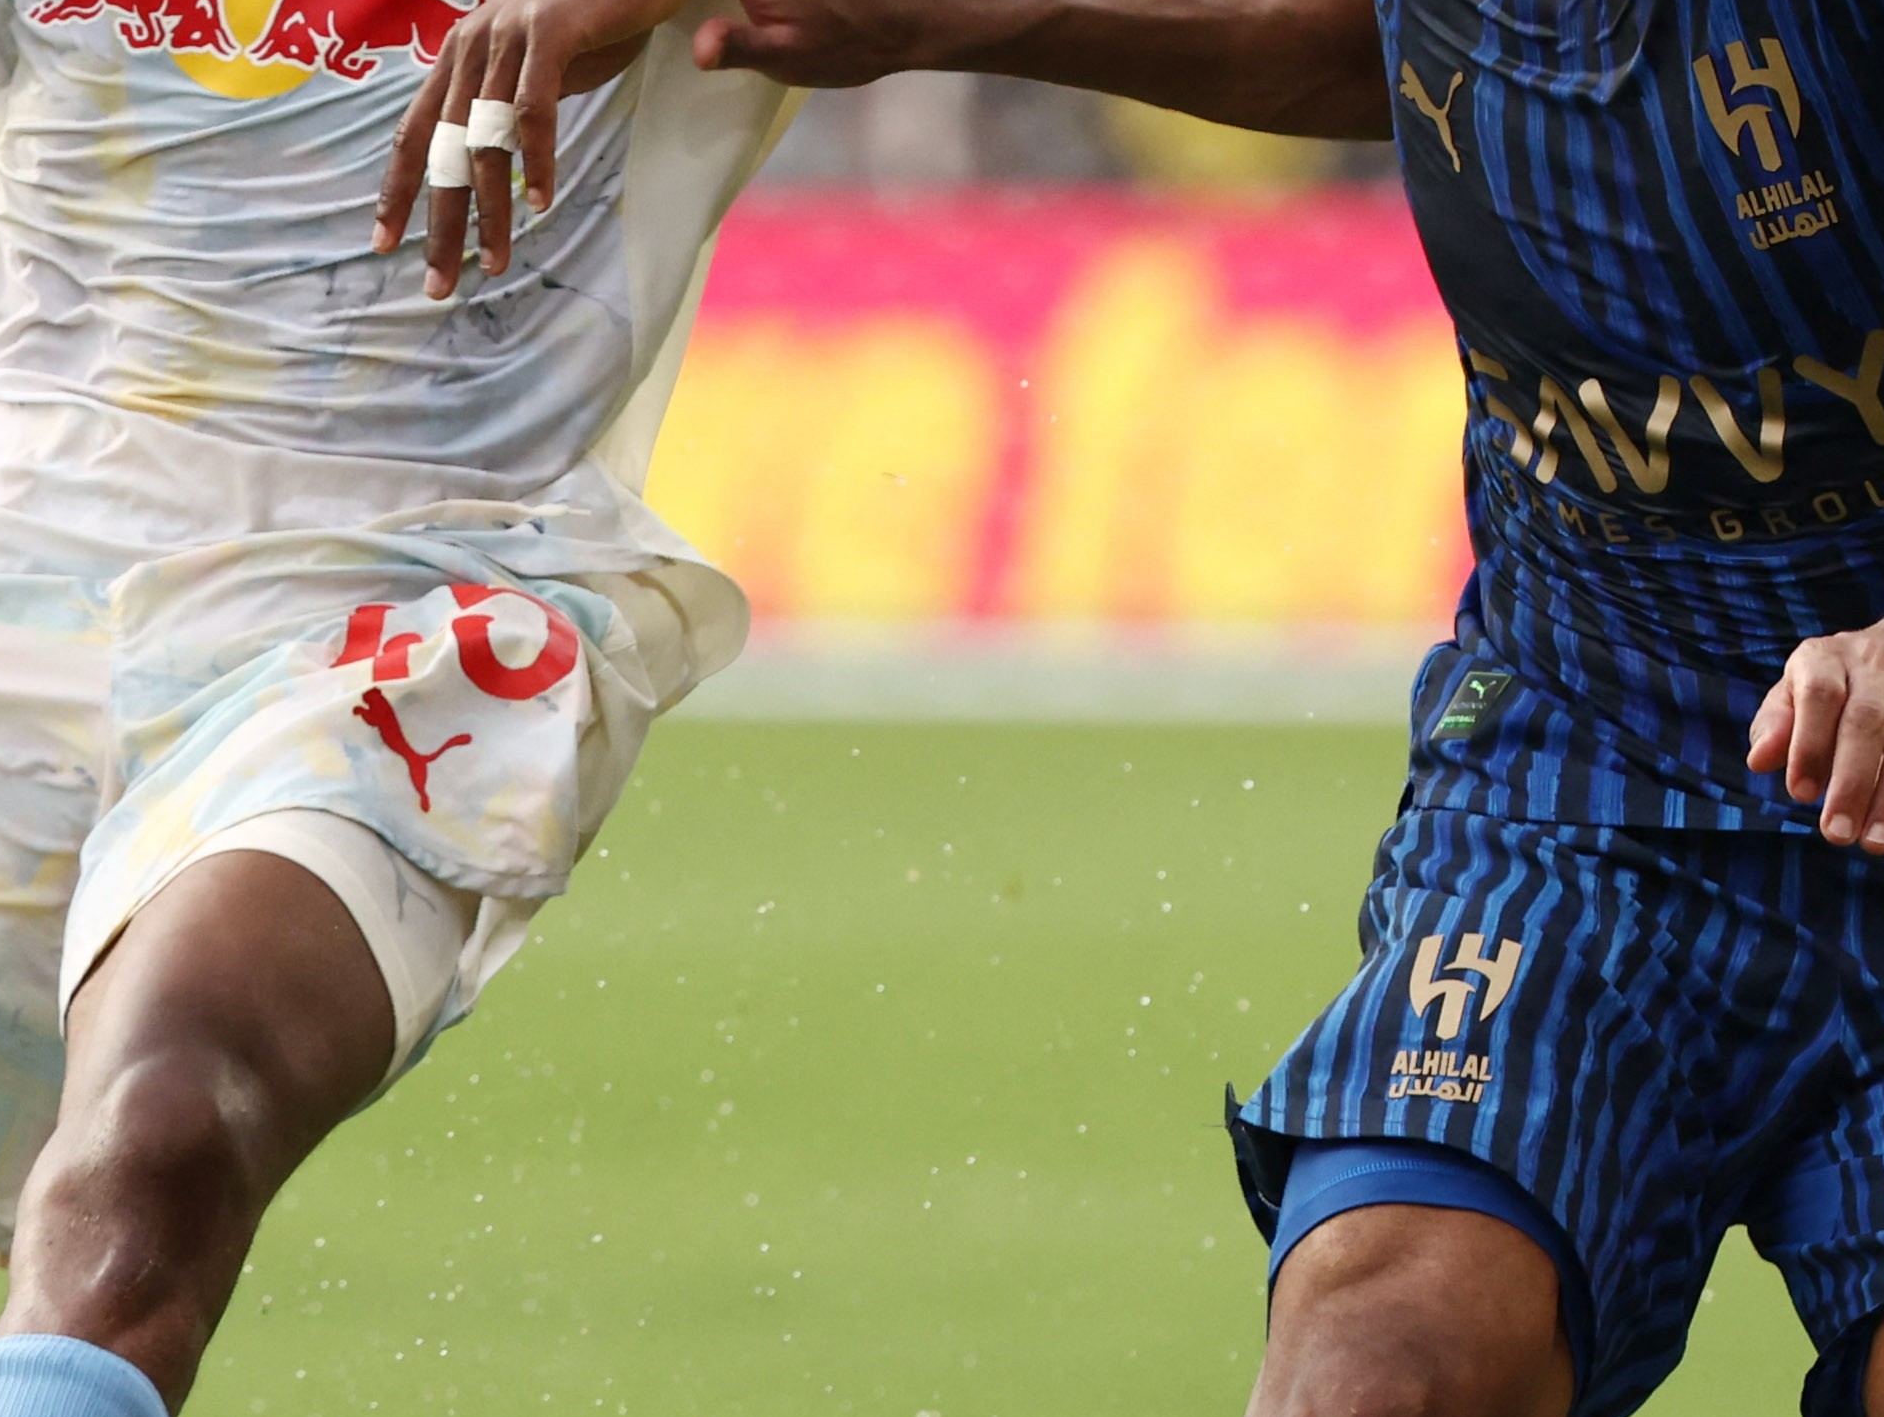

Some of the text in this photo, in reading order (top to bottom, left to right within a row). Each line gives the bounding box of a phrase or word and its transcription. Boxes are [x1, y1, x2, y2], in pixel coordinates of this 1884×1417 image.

[1735, 170, 1834, 220] ALHILAL
[1748, 198, 1839, 250] الهلال
[1390, 1050, 1493, 1081] ALHILAL
[1388, 1076, 1484, 1104] الهلال
